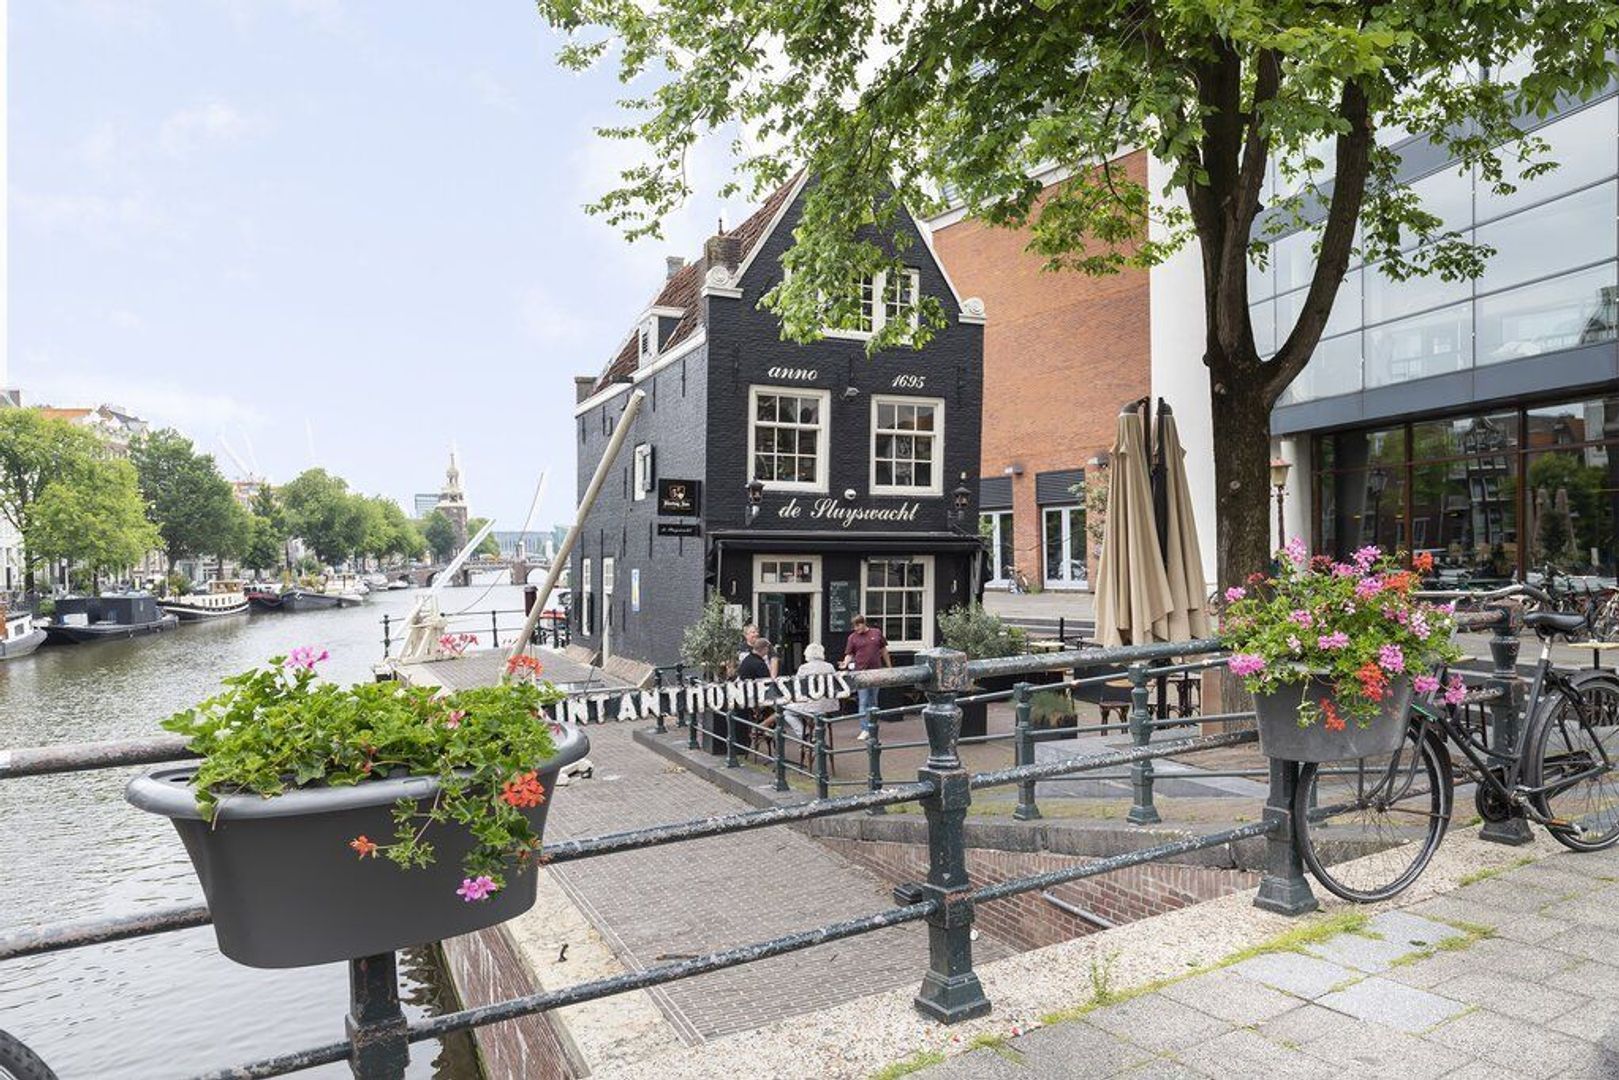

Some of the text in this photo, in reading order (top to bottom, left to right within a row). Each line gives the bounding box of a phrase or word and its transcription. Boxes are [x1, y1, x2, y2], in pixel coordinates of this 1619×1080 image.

[767, 365, 927, 389] anno 1695
[778, 497, 920, 528] de Sluyswacht
[554, 692, 610, 726] INT
